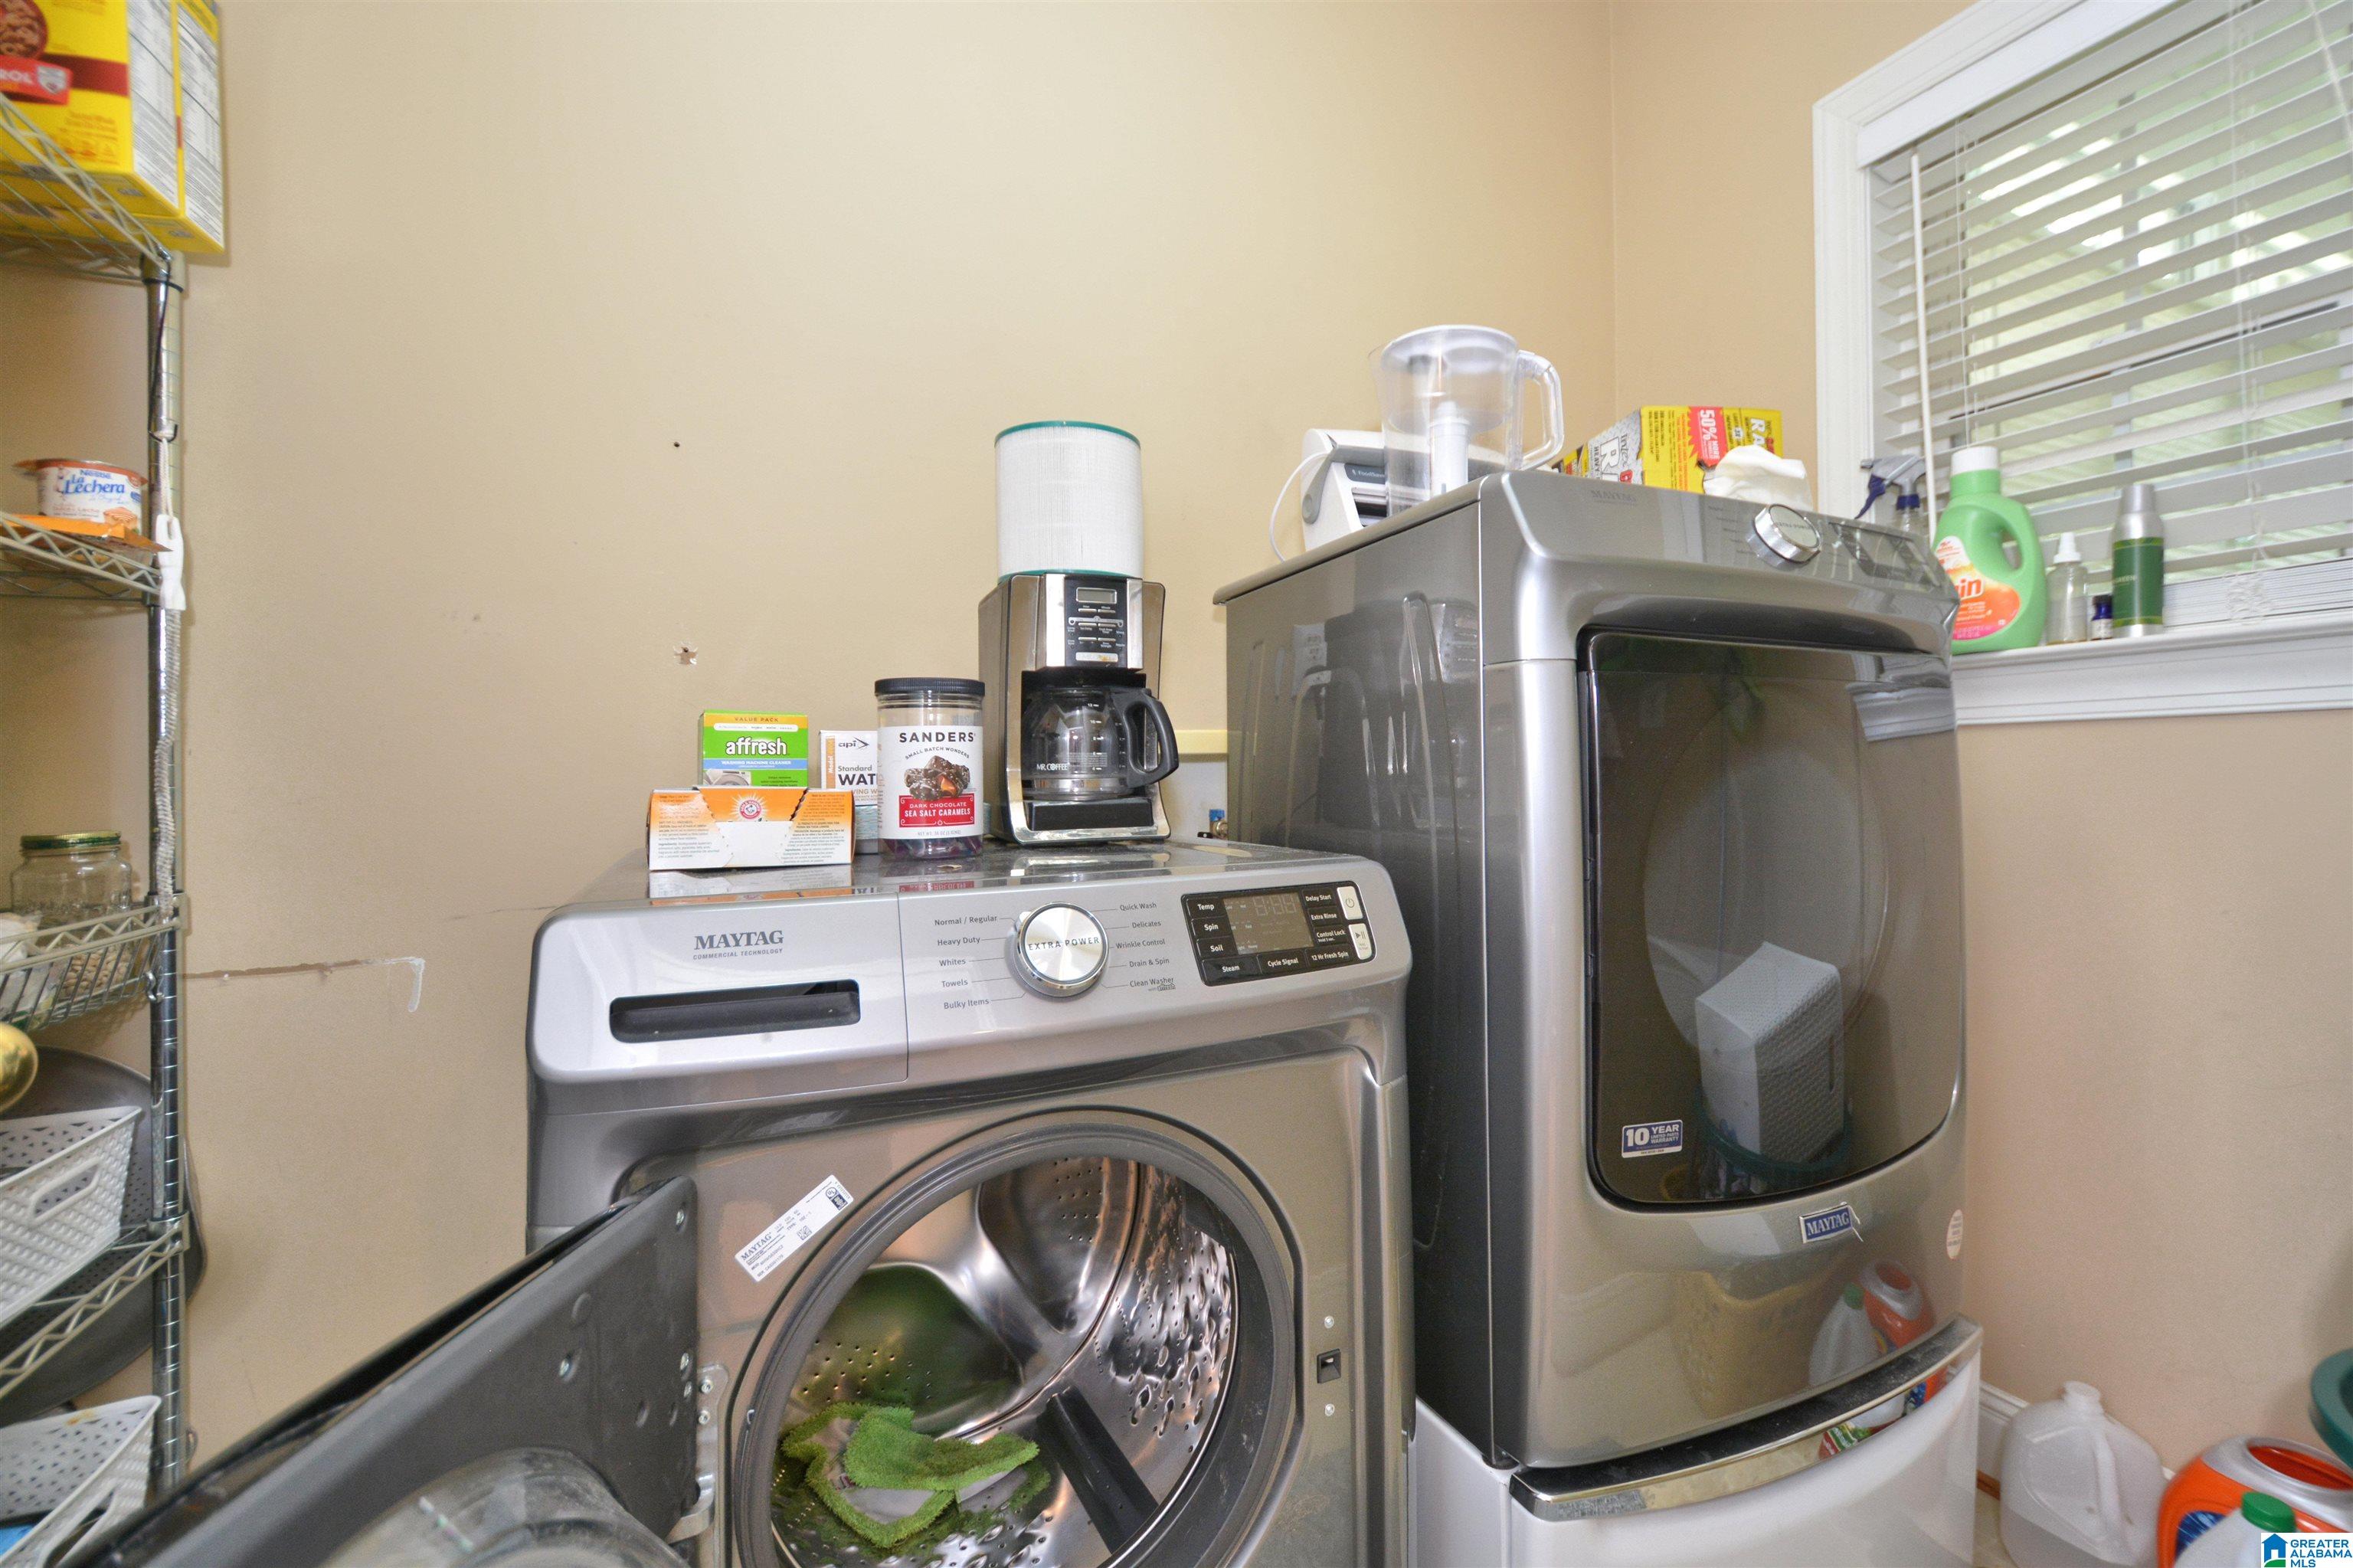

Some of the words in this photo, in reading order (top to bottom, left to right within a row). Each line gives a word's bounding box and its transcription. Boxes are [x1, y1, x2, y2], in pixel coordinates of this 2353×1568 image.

[1700, 409, 1718, 440] 50%
[1751, 417, 1766, 445] RA
[71, 474, 85, 484] La
[64, 479, 126, 495] Lechera
[898, 732, 974, 743] SANDERS
[725, 735, 787, 756] affresh
[838, 740, 857, 748] api
[905, 748, 923, 760] SMALL
[945, 746, 970, 759] WONDERS
[1046, 763, 1070, 771] COFFEE
[838, 773, 878, 787] WAT
[919, 809, 936, 817] SALT
[938, 807, 971, 817] CARAMELS
[1119, 903, 1137, 912] Quick
[1197, 903, 1215, 912] Temp
[934, 917, 962, 926] Normal
[969, 915, 997, 924] Regular
[1132, 920, 1162, 928] Delicates
[1204, 923, 1219, 931] Spin
[694, 930, 784, 951] MAYTAG
[937, 938, 961, 947] Heavy
[963, 936, 980, 945] Duty
[1028, 941, 1062, 951] EXTRA
[1065, 937, 1100, 947] POWER
[1115, 941, 1141, 950] Wrinkle
[1143, 938, 1166, 947] Control
[693, 951, 738, 960] COMMERCIAL
[740, 948, 783, 957] TECHNOLOGY
[1324, 951, 1337, 960] Fresh
[939, 957, 966, 967] Whites
[1129, 959, 1147, 967] Drain
[1154, 957, 1170, 966] Spin
[1282, 957, 1299, 966] Signal
[1222, 964, 1240, 973] Steam
[942, 978, 968, 987] Towels
[1150, 977, 1174, 986] Washer
[944, 1000, 967, 1010] Bulky
[967, 997, 990, 1007] Items
[1626, 1127, 1650, 1147] 10
[1651, 1124, 1680, 1134] YEAR
[1807, 1212, 1850, 1236] MAYTAG
[741, 1233, 771, 1260] MAYTAG
